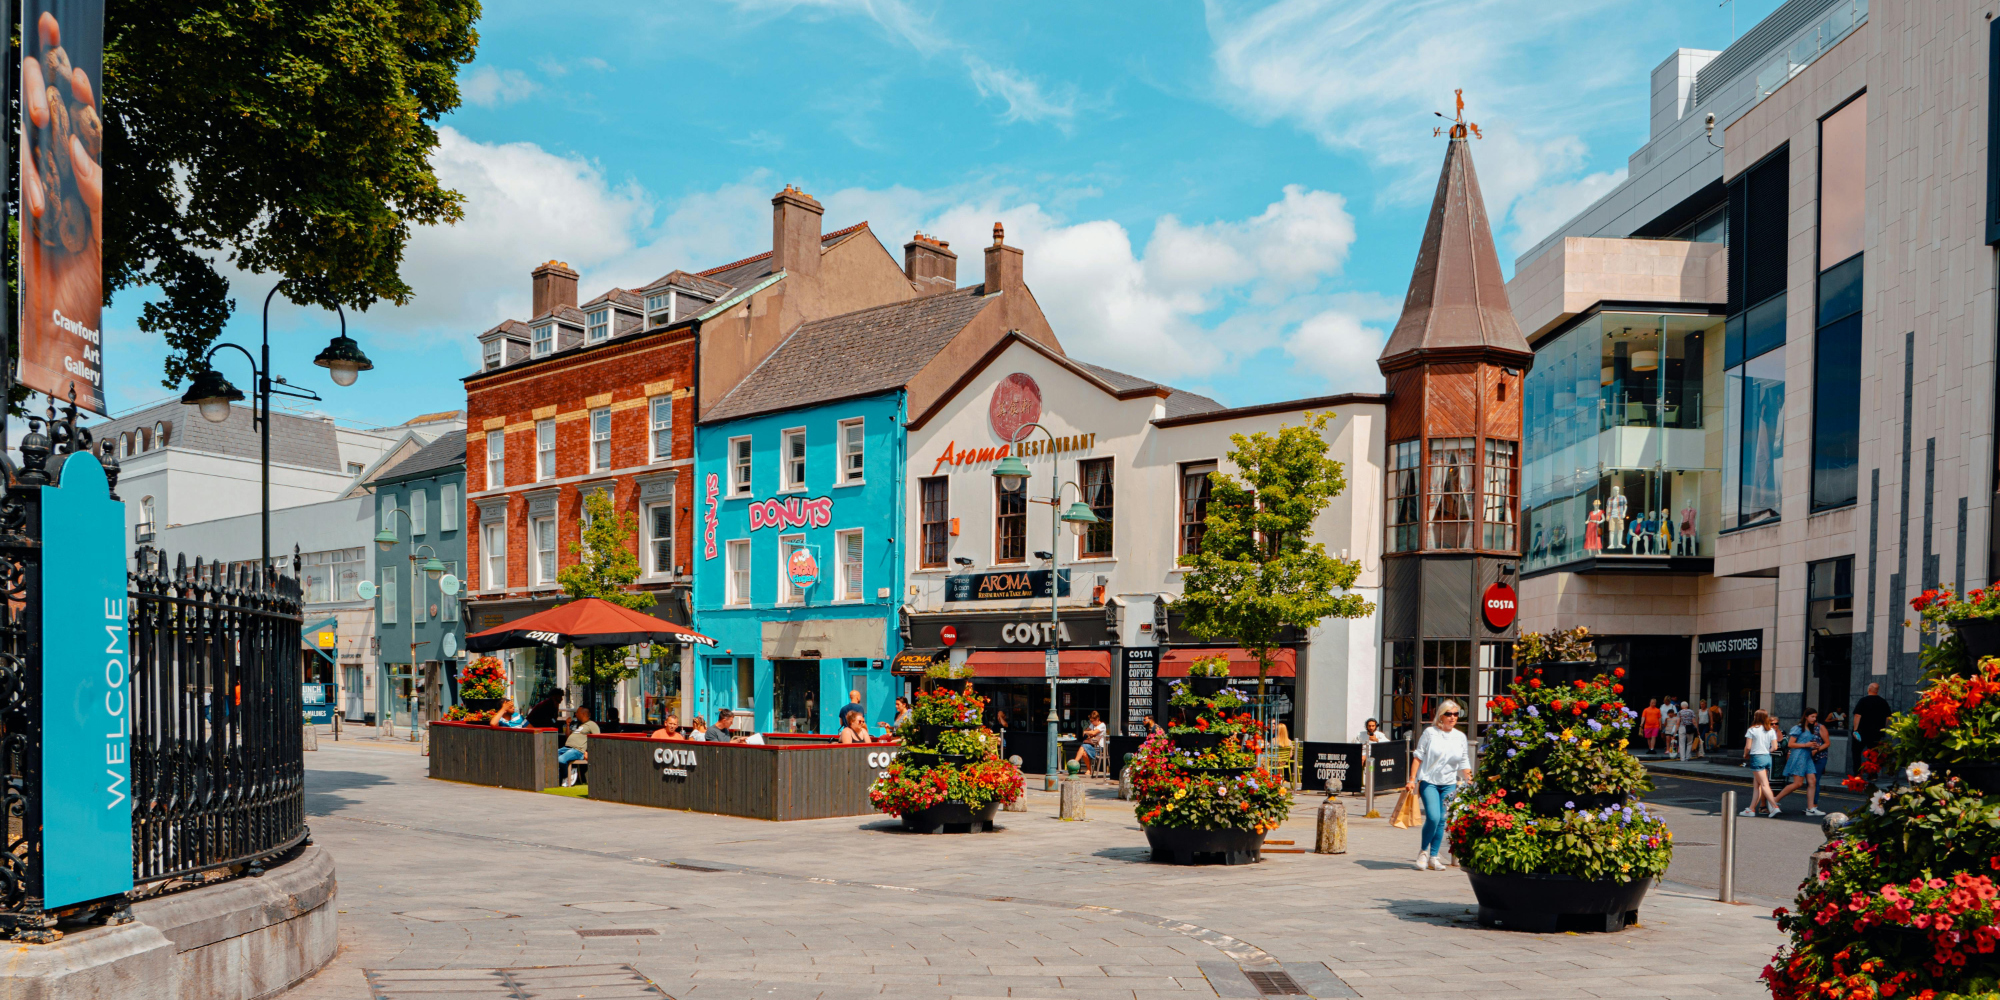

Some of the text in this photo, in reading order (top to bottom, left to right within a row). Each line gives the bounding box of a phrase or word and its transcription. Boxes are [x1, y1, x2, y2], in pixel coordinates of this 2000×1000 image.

[53, 309, 99, 345] Crawford
[83, 344, 100, 365] Art
[64, 356, 100, 387] Gallery
[932, 433, 1096, 475] Aroma RESTAURANT
[704, 472, 719, 560] DONUTS
[748, 495, 834, 532] DONUTS
[979, 573, 1032, 592] AROMA
[1487, 599, 1514, 610] COSTA
[525, 630, 560, 645] COSTA
[674, 633, 714, 648] COSTA
[1002, 622, 1071, 646] COSTA
[1698, 637, 1758, 654] DUNNES STORES
[1129, 650, 1153, 658] COSTA
[1129, 669, 1153, 677] COFFEE
[1129, 687, 1152, 695] DRINKS
[105, 597, 126, 810] WELCOME
[1128, 724, 1146, 732] CAKES
[654, 747, 697, 767] COSTA
[1314, 760, 1350, 769] irresistible
[1380, 759, 1395, 767] COSTA
[663, 768, 688, 777] COFFEE
[1317, 769, 1346, 780] COFFEE
